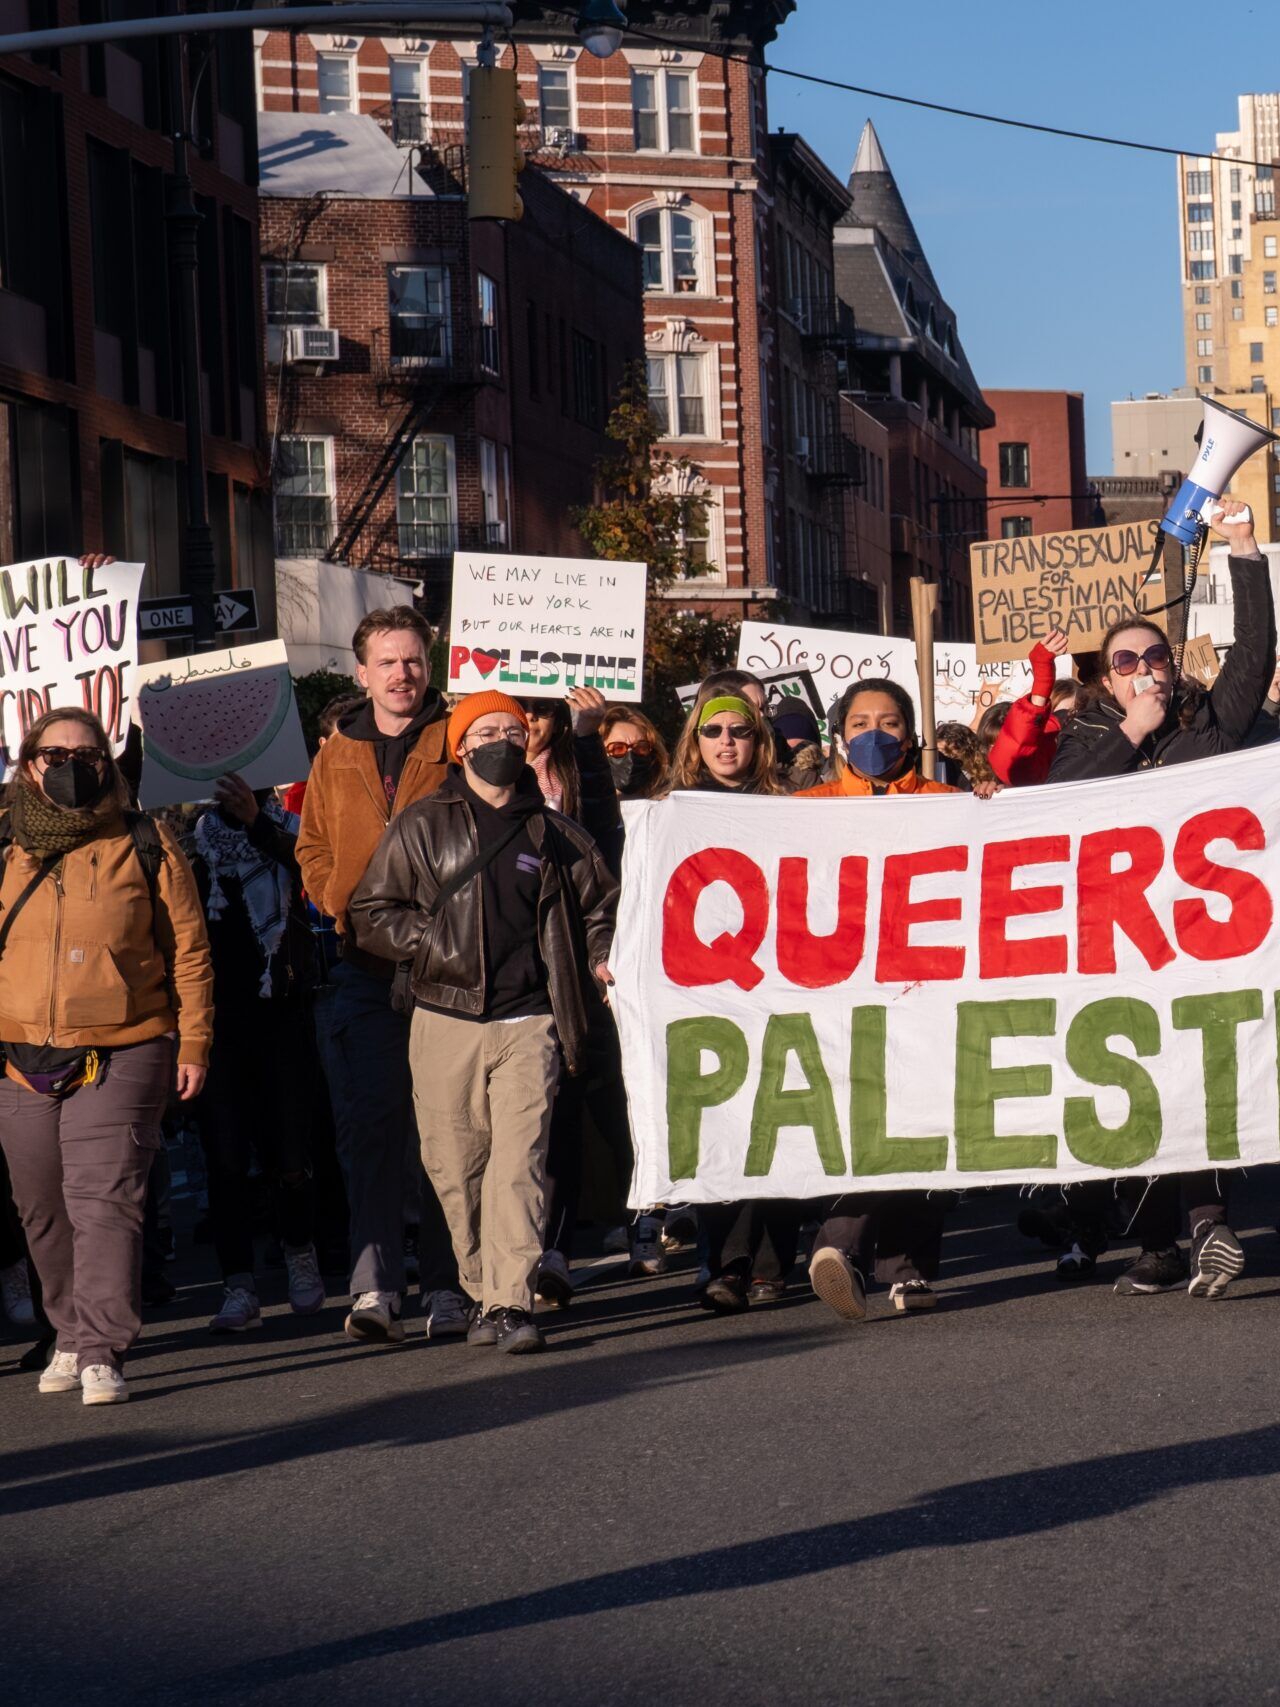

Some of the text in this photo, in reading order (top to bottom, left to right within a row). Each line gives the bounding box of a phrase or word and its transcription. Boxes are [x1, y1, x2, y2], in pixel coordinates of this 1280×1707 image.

[972, 519, 1162, 577] TRANSSEXUALS
[468, 563, 617, 588] WE MAY LIVE IN
[1040, 569, 1075, 586] FOR
[0, 559, 108, 619] WILL
[493, 592, 593, 611] NEW YORK
[978, 572, 1138, 619] PALESTINIAN
[150, 602, 237, 628] ONE AY
[0, 599, 129, 679] VE YOU
[461, 618, 635, 640] BUT OUR HEARTS ARE IN
[977, 661, 1010, 678] ARE
[969, 689, 993, 707] TO
[661, 804, 1274, 992] QUEERS
